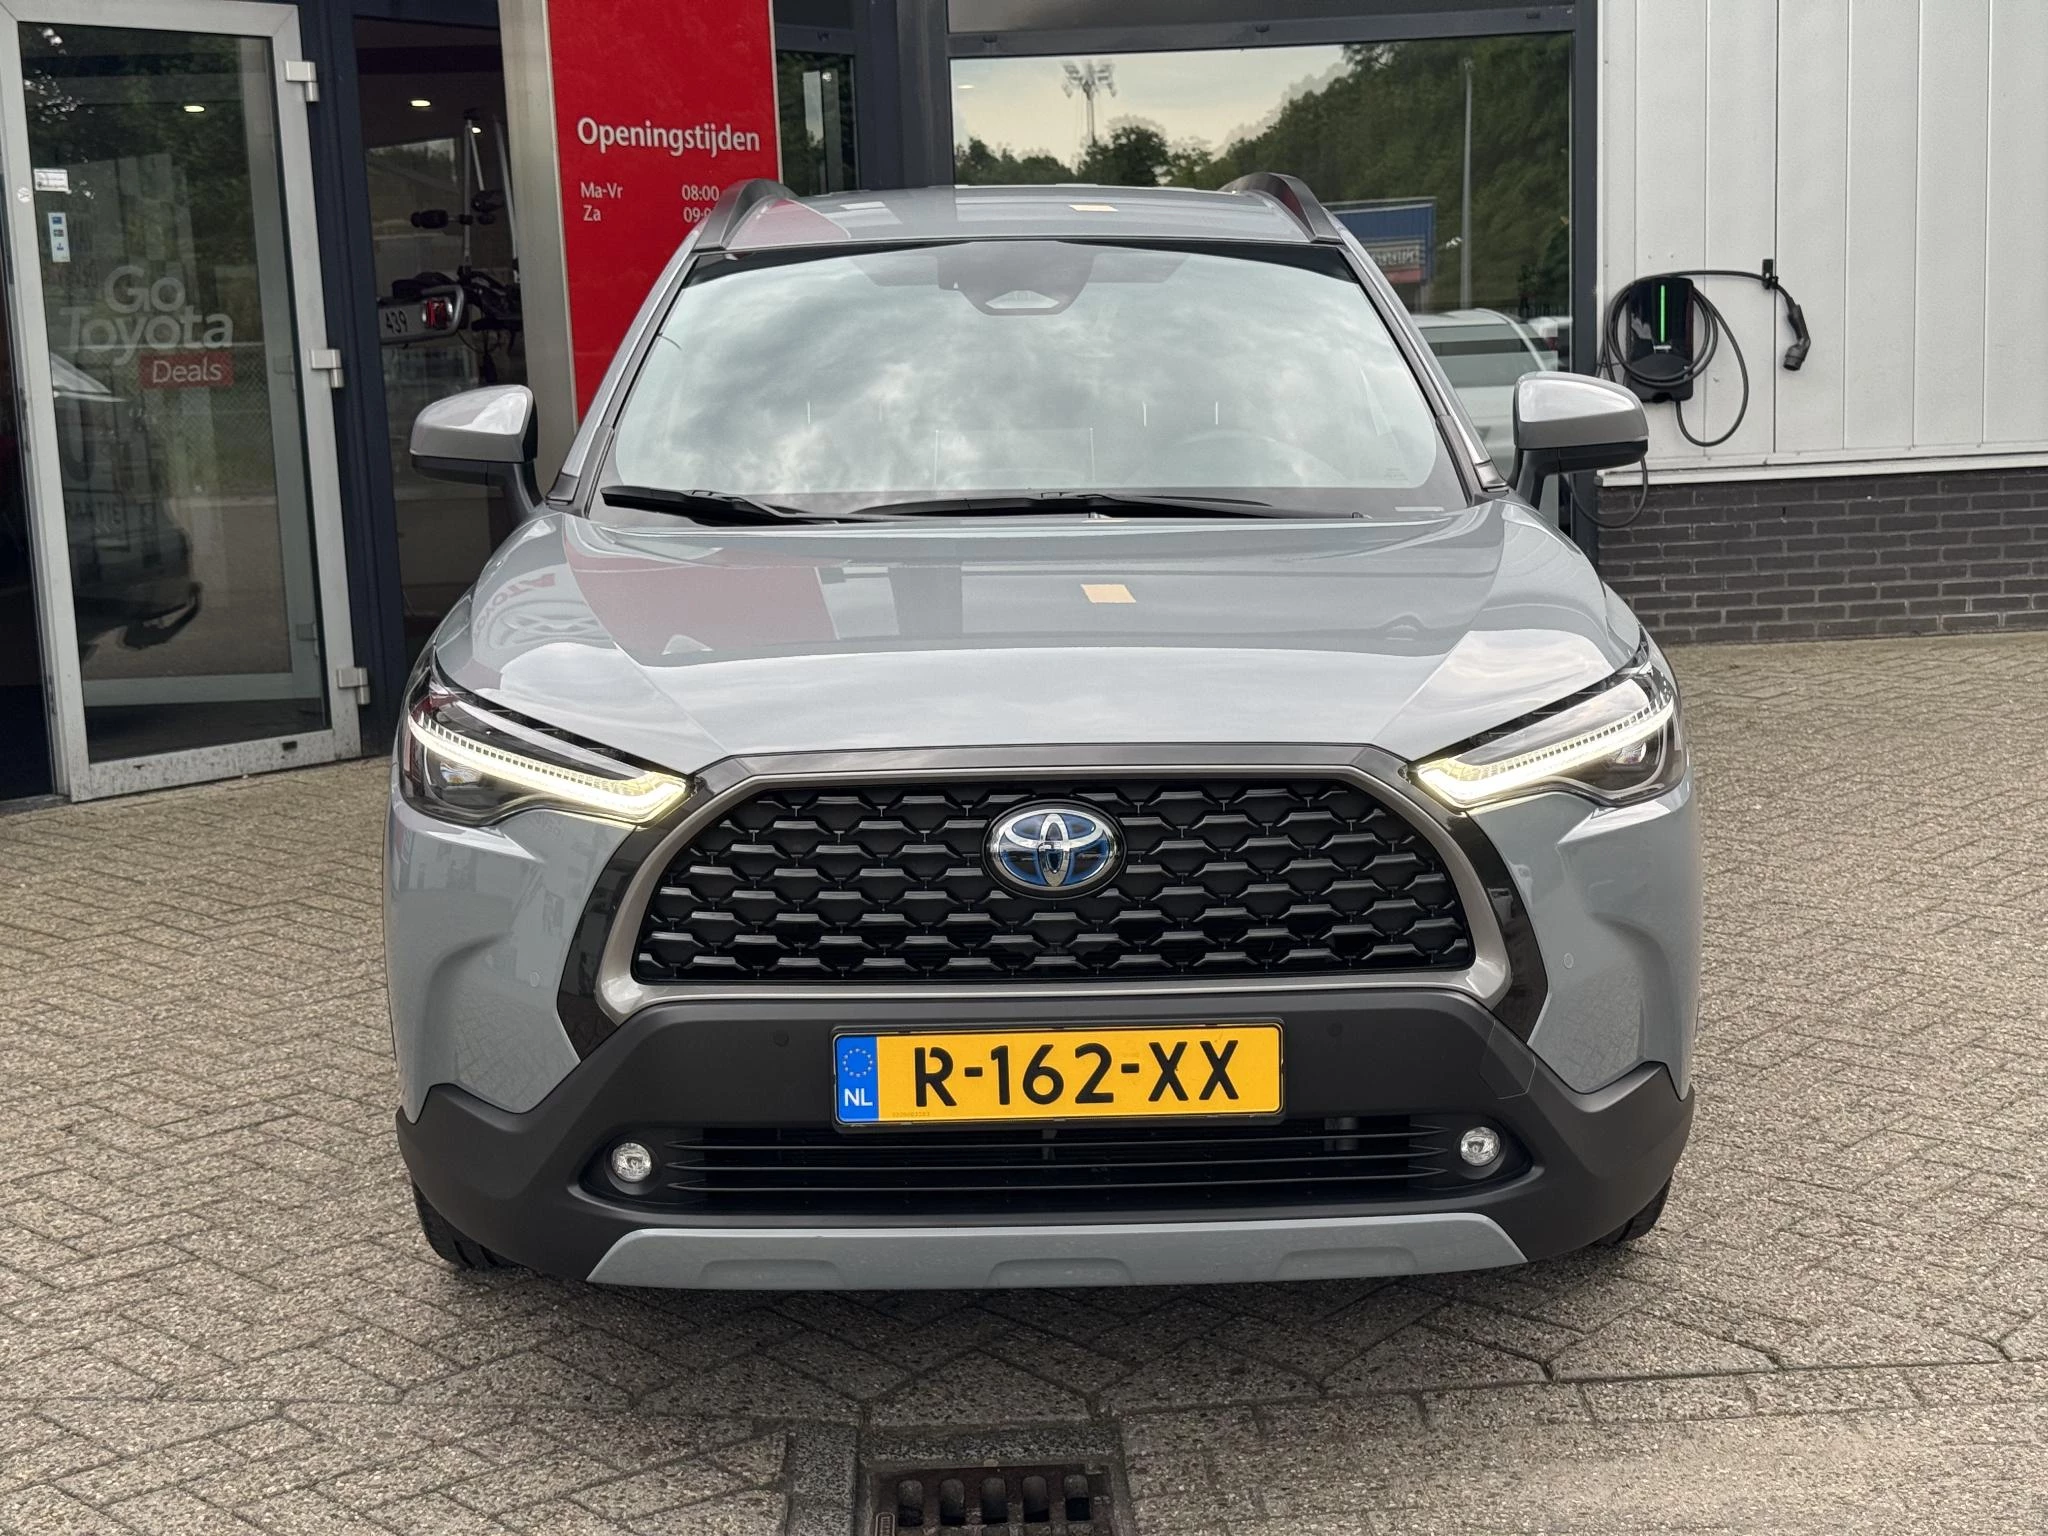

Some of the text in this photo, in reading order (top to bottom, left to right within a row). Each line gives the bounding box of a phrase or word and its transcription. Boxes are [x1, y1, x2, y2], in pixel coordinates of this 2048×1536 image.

[577, 116, 760, 158] Openingstijden
[580, 182, 720, 201] Ma-Vr 08:00
[583, 205, 601, 221] Za
[104, 265, 186, 314] Go
[59, 305, 234, 366] Toyota
[152, 356, 222, 383] Deals
[914, 1040, 1239, 1108] R-162-XX
[844, 1088, 873, 1106] NL
